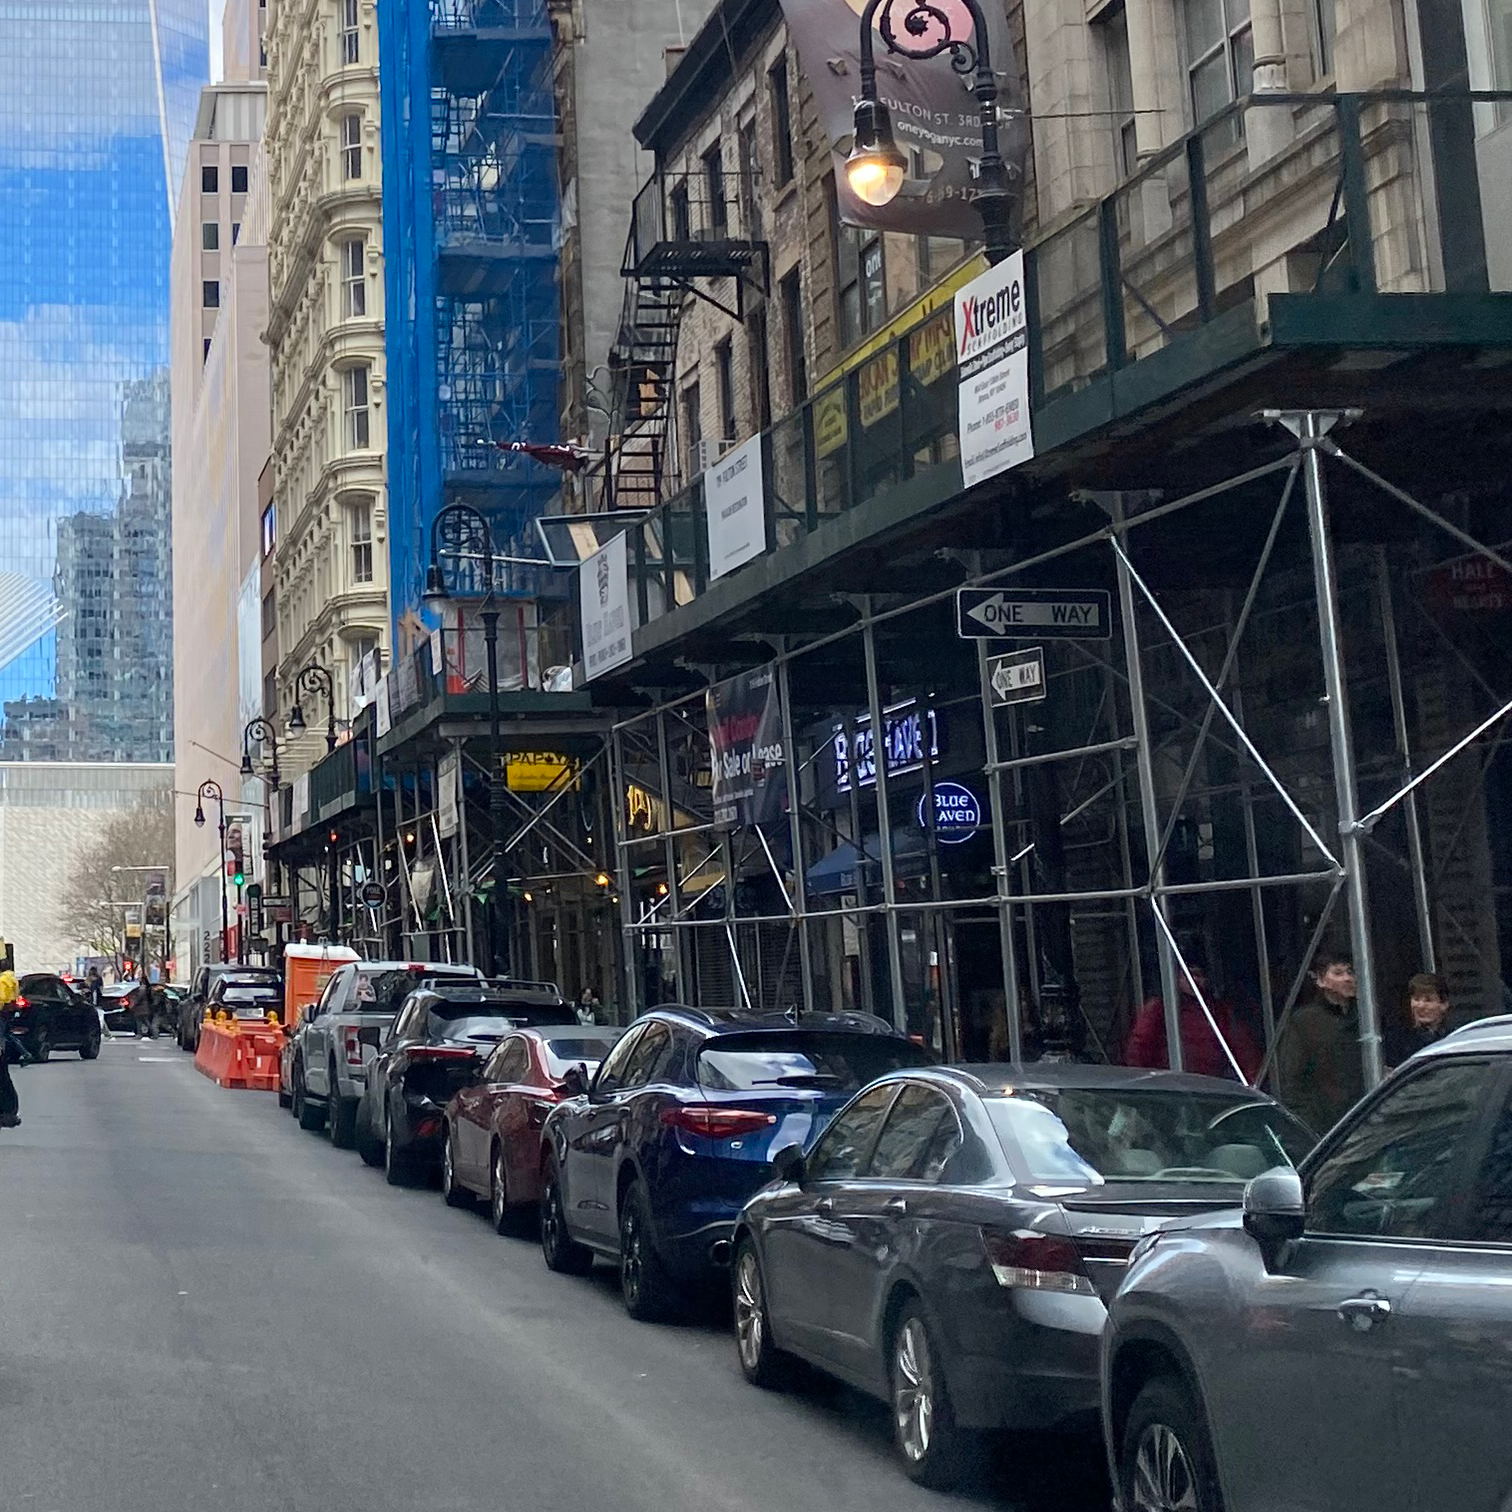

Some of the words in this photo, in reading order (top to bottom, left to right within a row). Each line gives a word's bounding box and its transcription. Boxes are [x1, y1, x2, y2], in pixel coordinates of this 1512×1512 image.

[961, 279, 1021, 356] Xtreme
[984, 604, 1024, 623] ONE
[1051, 605, 1092, 624] WAY
[996, 669, 1013, 690] ONE
[1018, 664, 1036, 683] WAY
[723, 748, 741, 780] Sale
[938, 809, 975, 822] AVEN
